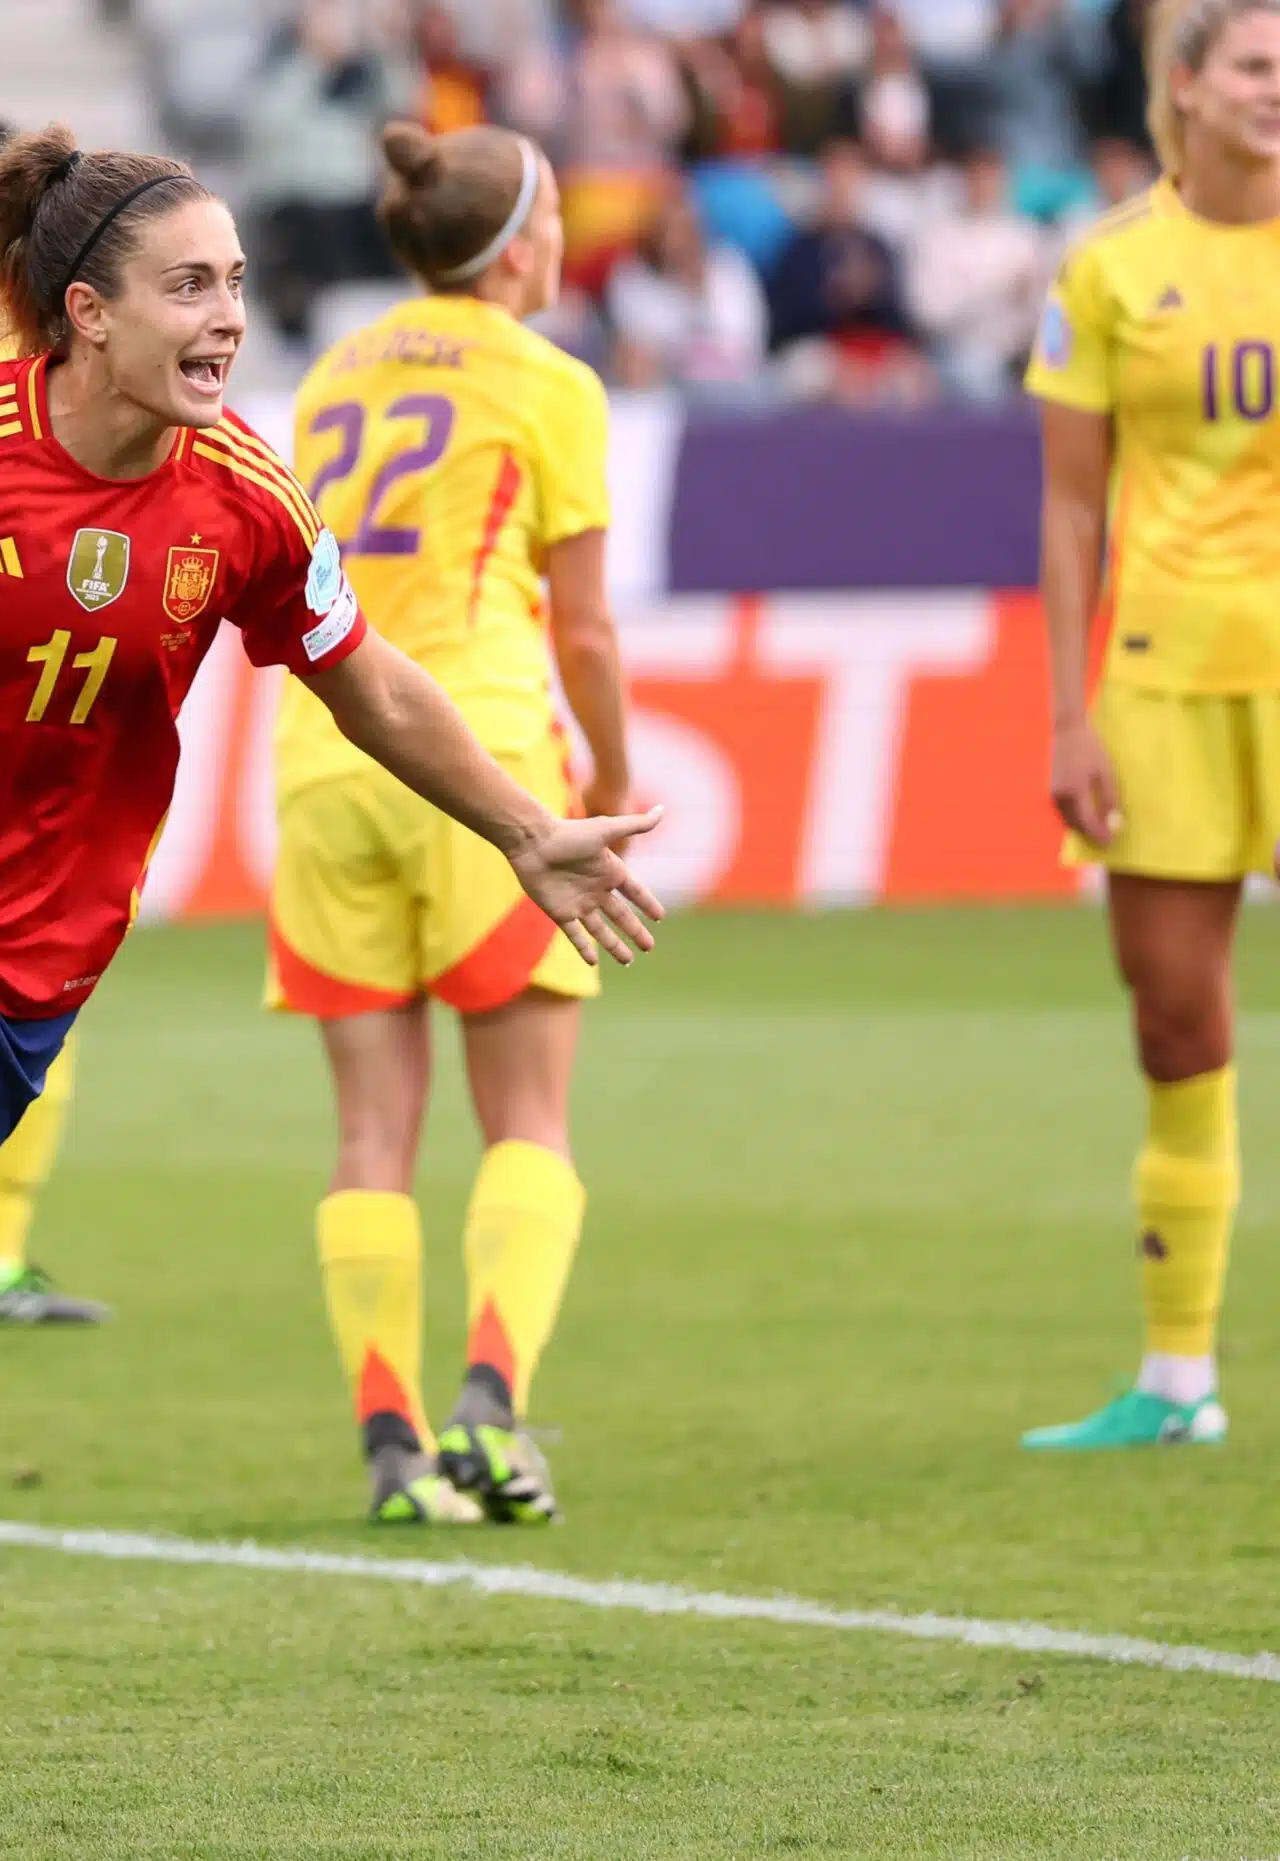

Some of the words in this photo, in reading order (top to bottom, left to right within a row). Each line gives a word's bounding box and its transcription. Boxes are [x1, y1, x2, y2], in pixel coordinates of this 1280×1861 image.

[1201, 338, 1274, 424] 10
[307, 392, 454, 557] 22
[82, 578, 108, 593] FIFA
[25, 628, 118, 724] 11
